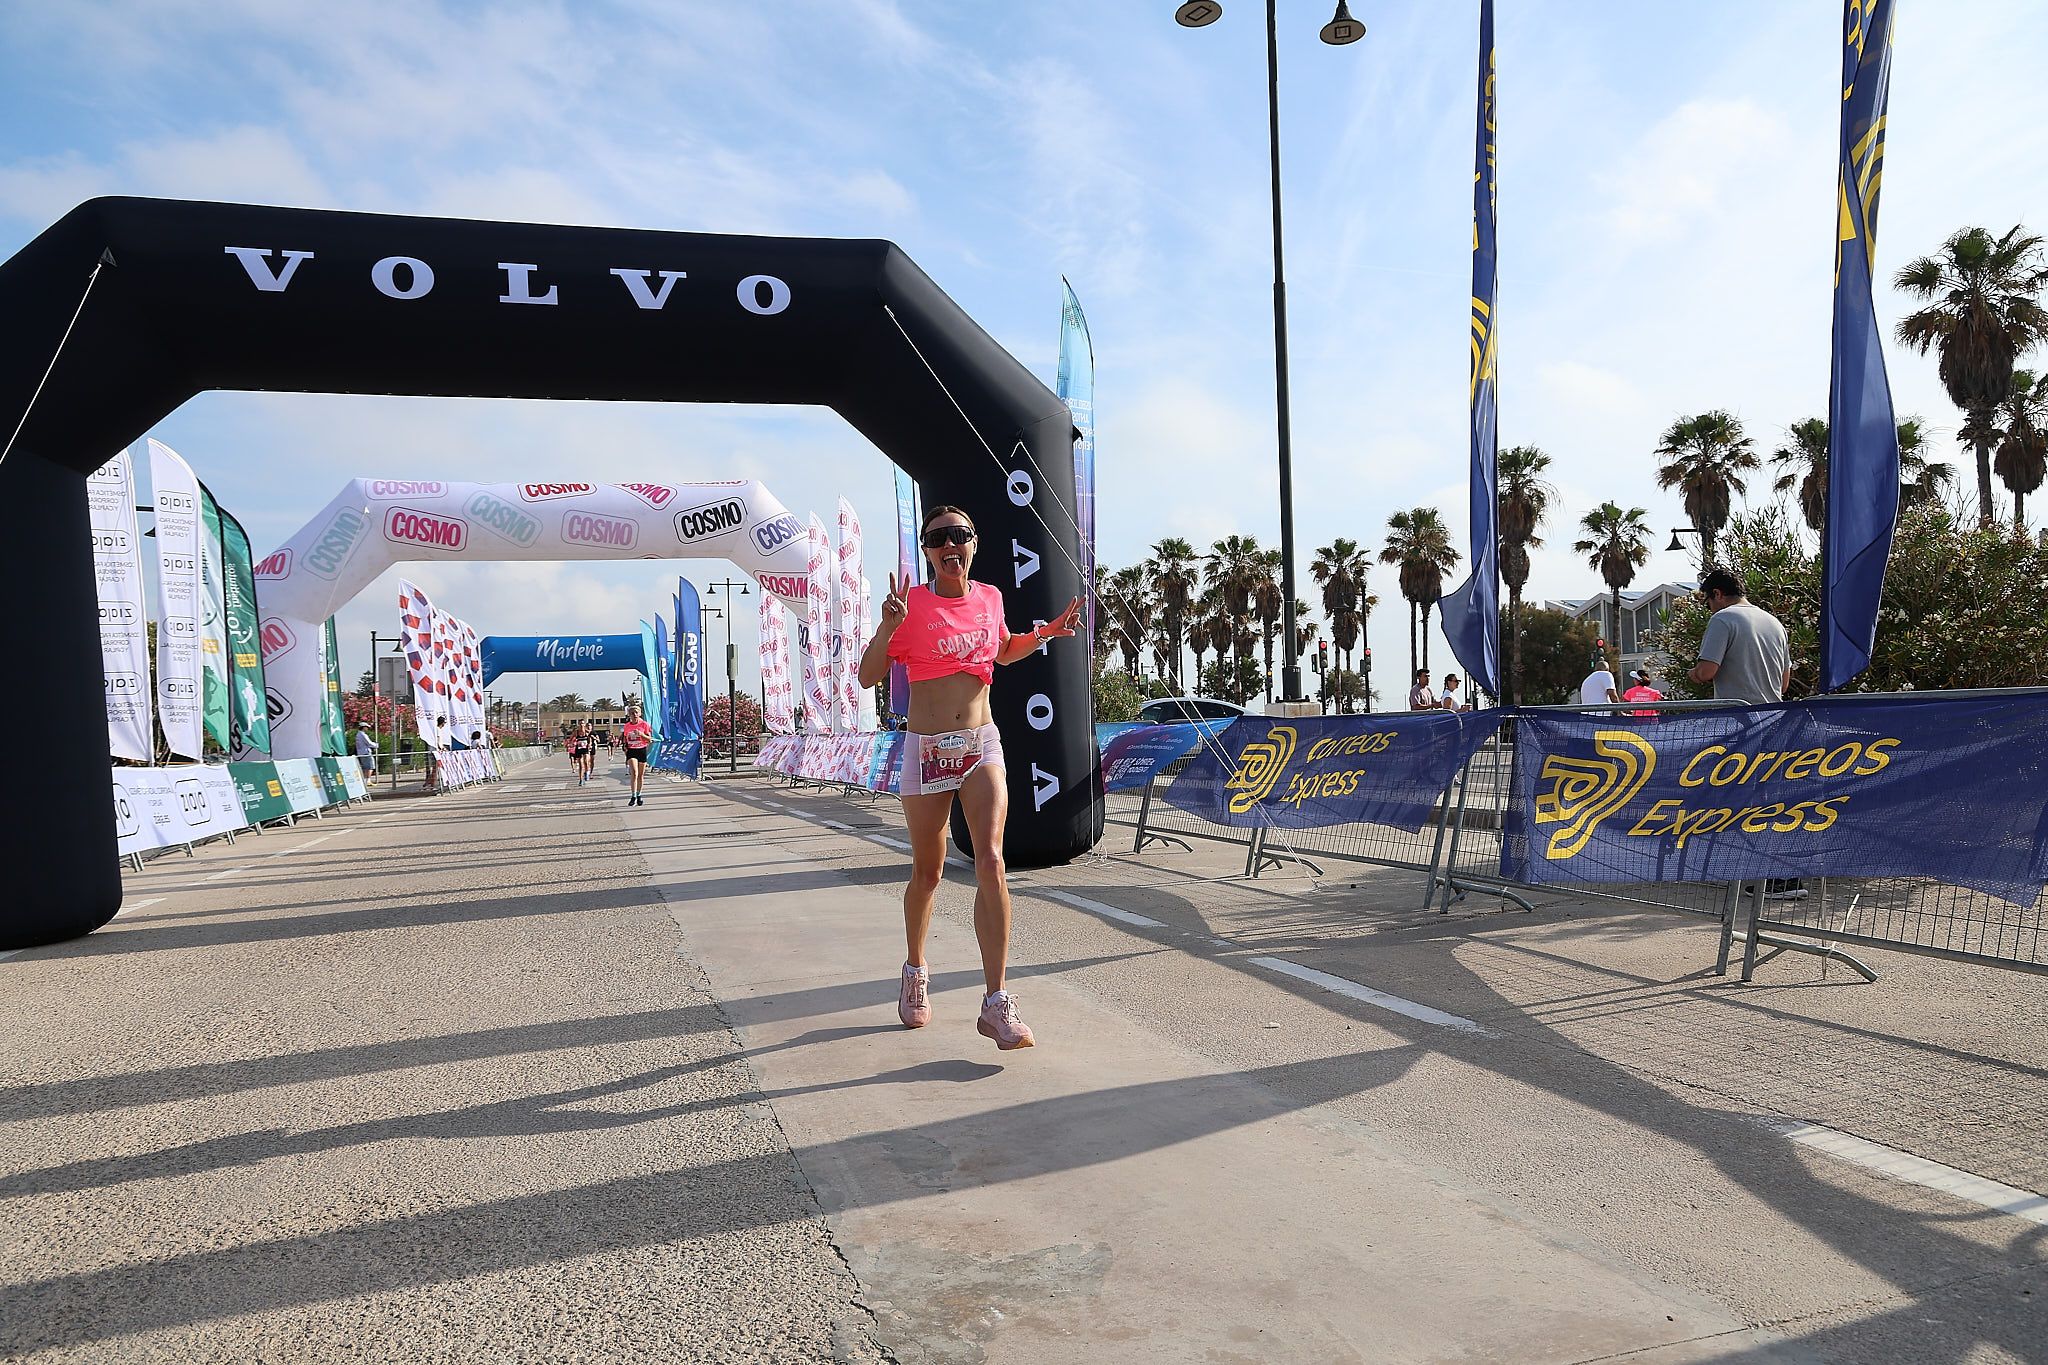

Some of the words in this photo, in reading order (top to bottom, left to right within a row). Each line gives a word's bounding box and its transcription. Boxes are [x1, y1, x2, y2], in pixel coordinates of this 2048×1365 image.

[225, 246, 791, 315] VOLVO
[372, 480, 441, 496] COSMO
[392, 511, 461, 547] COSMO
[470, 494, 536, 543] COSMO
[568, 515, 633, 546] COSMO
[681, 501, 742, 539] COSMO
[309, 510, 364, 575] COSMO
[939, 758, 964, 769] 016
[1306, 731, 1399, 764] Correos
[1679, 737, 1902, 787] Correos
[1279, 769, 1366, 809] Express
[1627, 796, 1850, 849] Express
